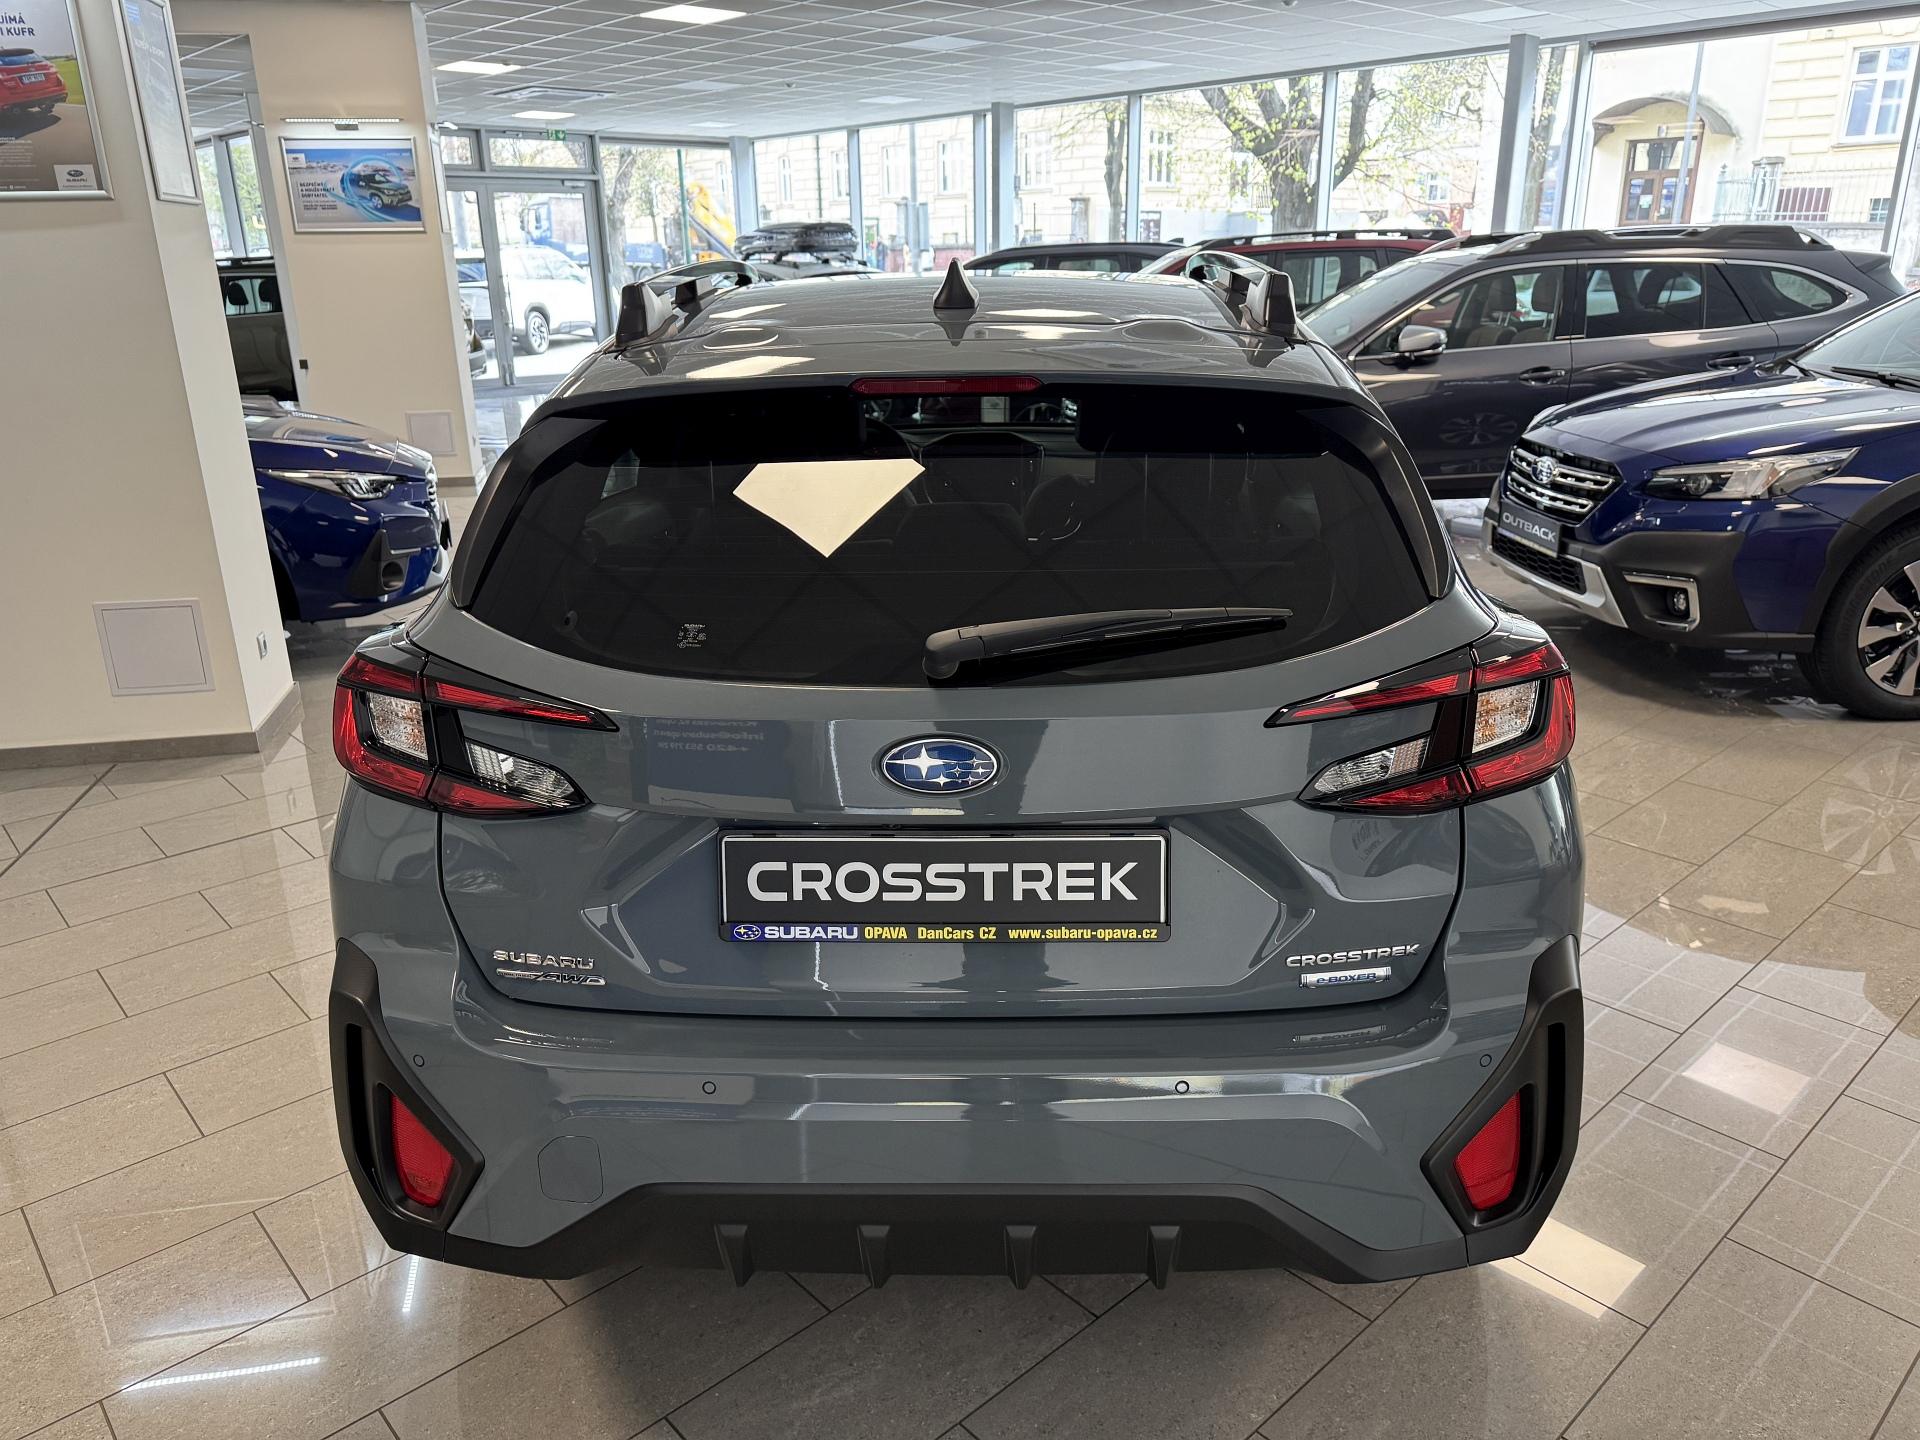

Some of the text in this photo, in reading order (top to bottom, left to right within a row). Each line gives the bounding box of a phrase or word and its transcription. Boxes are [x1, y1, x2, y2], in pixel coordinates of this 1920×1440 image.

[6, 27, 36, 36] KUFR
[1502, 512, 1556, 543] OUTBACK
[747, 861, 1139, 902] CROSSTREK
[764, 926, 1158, 941] SUBARU OPAVA DanCars CZ www.subaru-opava.cz
[493, 950, 595, 970] SUBARU
[1286, 943, 1420, 967] CROSSTREK
[534, 972, 606, 986] AWD
[1316, 972, 1377, 984] e-BOXER
